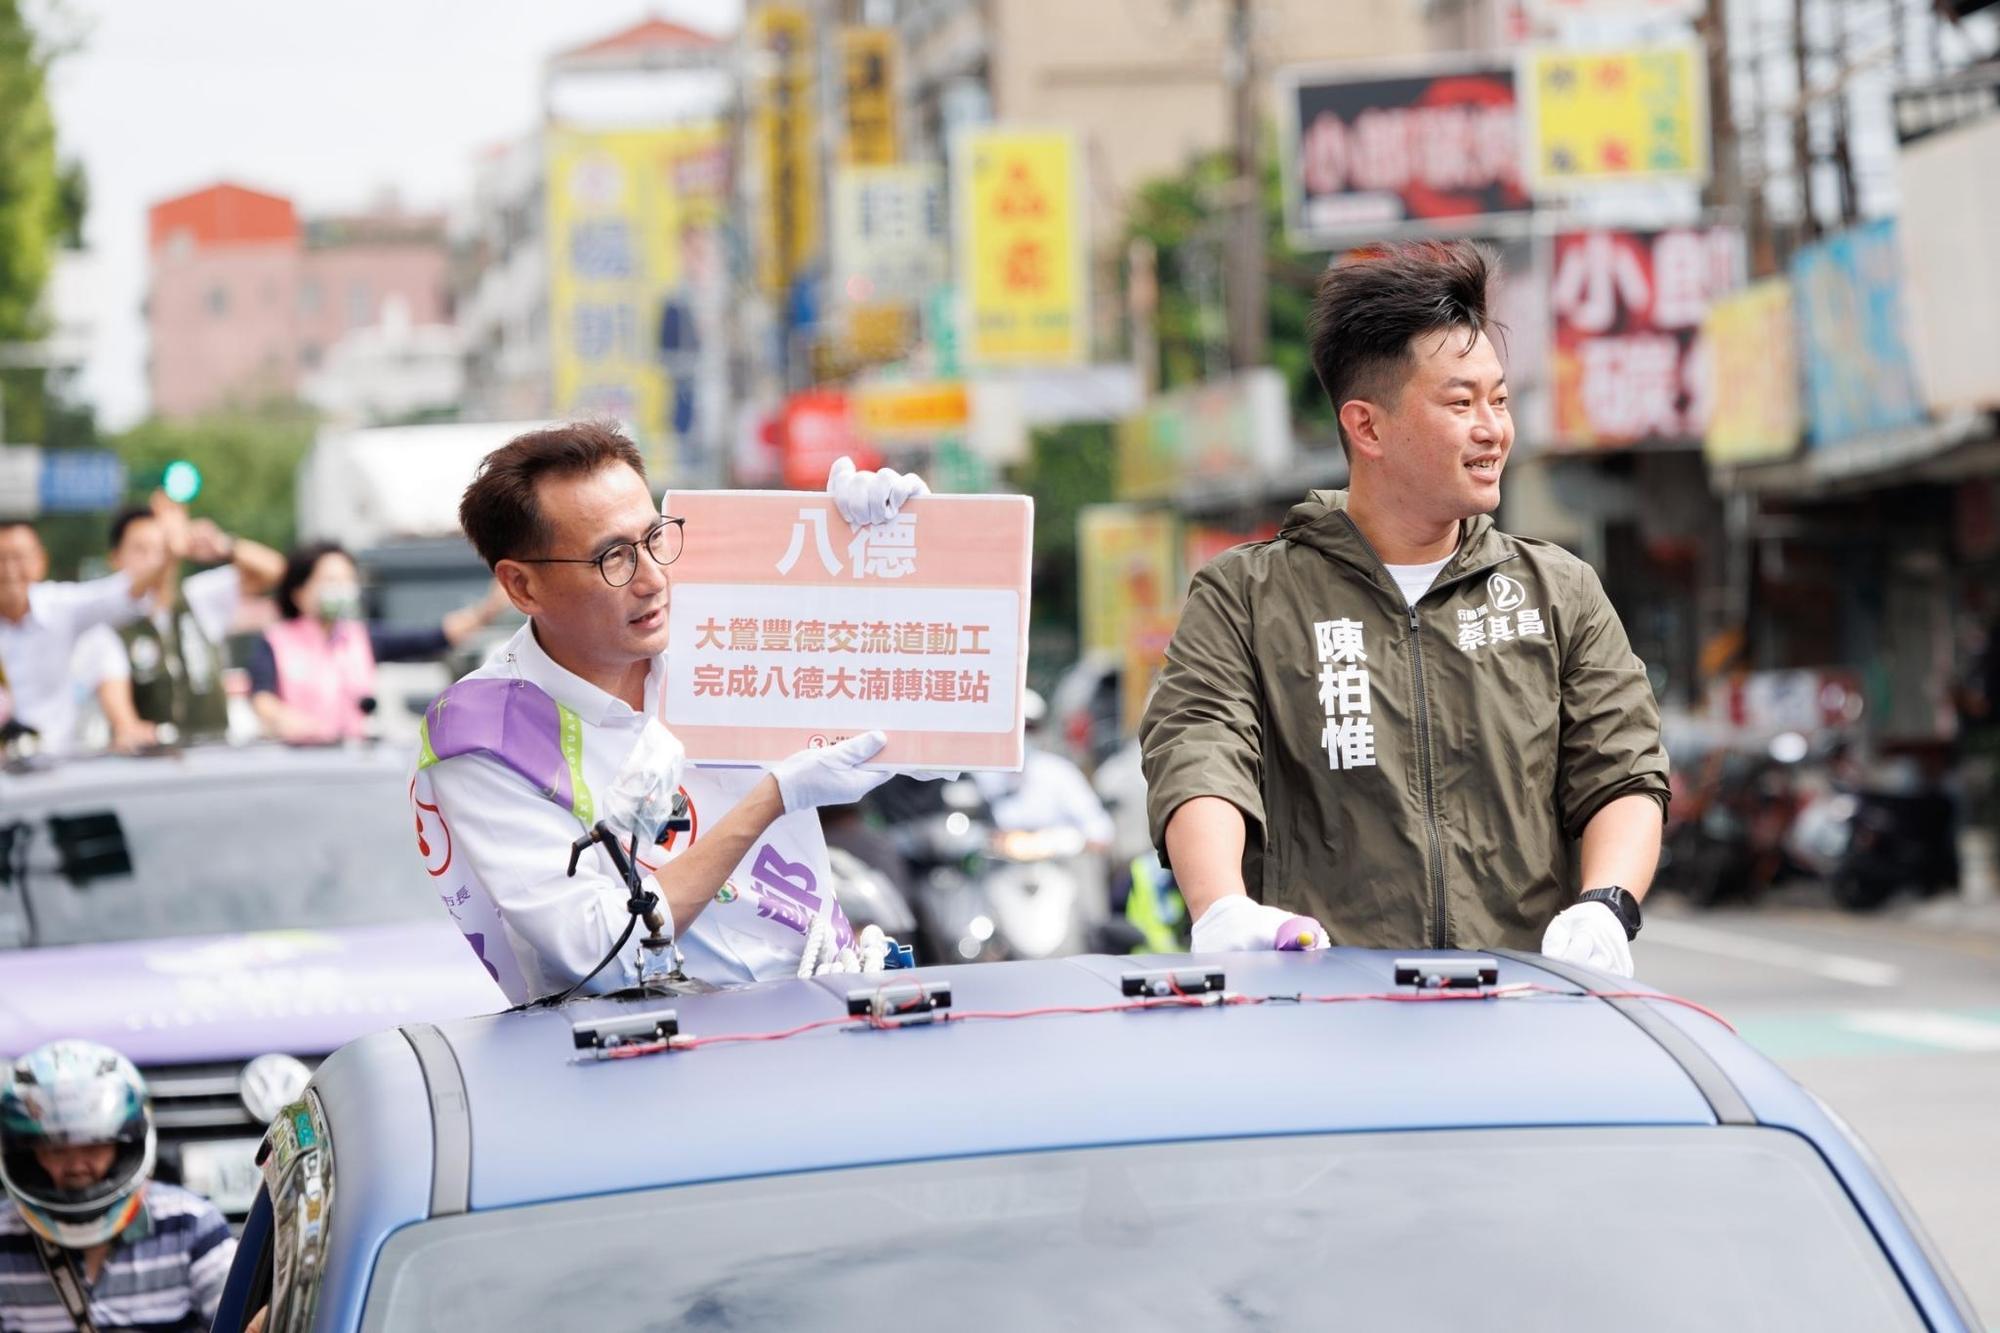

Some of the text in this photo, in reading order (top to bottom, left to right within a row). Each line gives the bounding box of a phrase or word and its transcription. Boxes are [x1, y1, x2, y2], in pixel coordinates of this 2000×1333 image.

[775, 507, 917, 579] 八德
[1492, 575, 1521, 609] 2
[695, 617, 991, 656] 大鶯豐德交流道動工
[1458, 607, 1545, 652] 蔡其昌
[693, 664, 991, 703] 完成八德大湳轉運站
[1313, 618, 1377, 770] 陳柏惟
